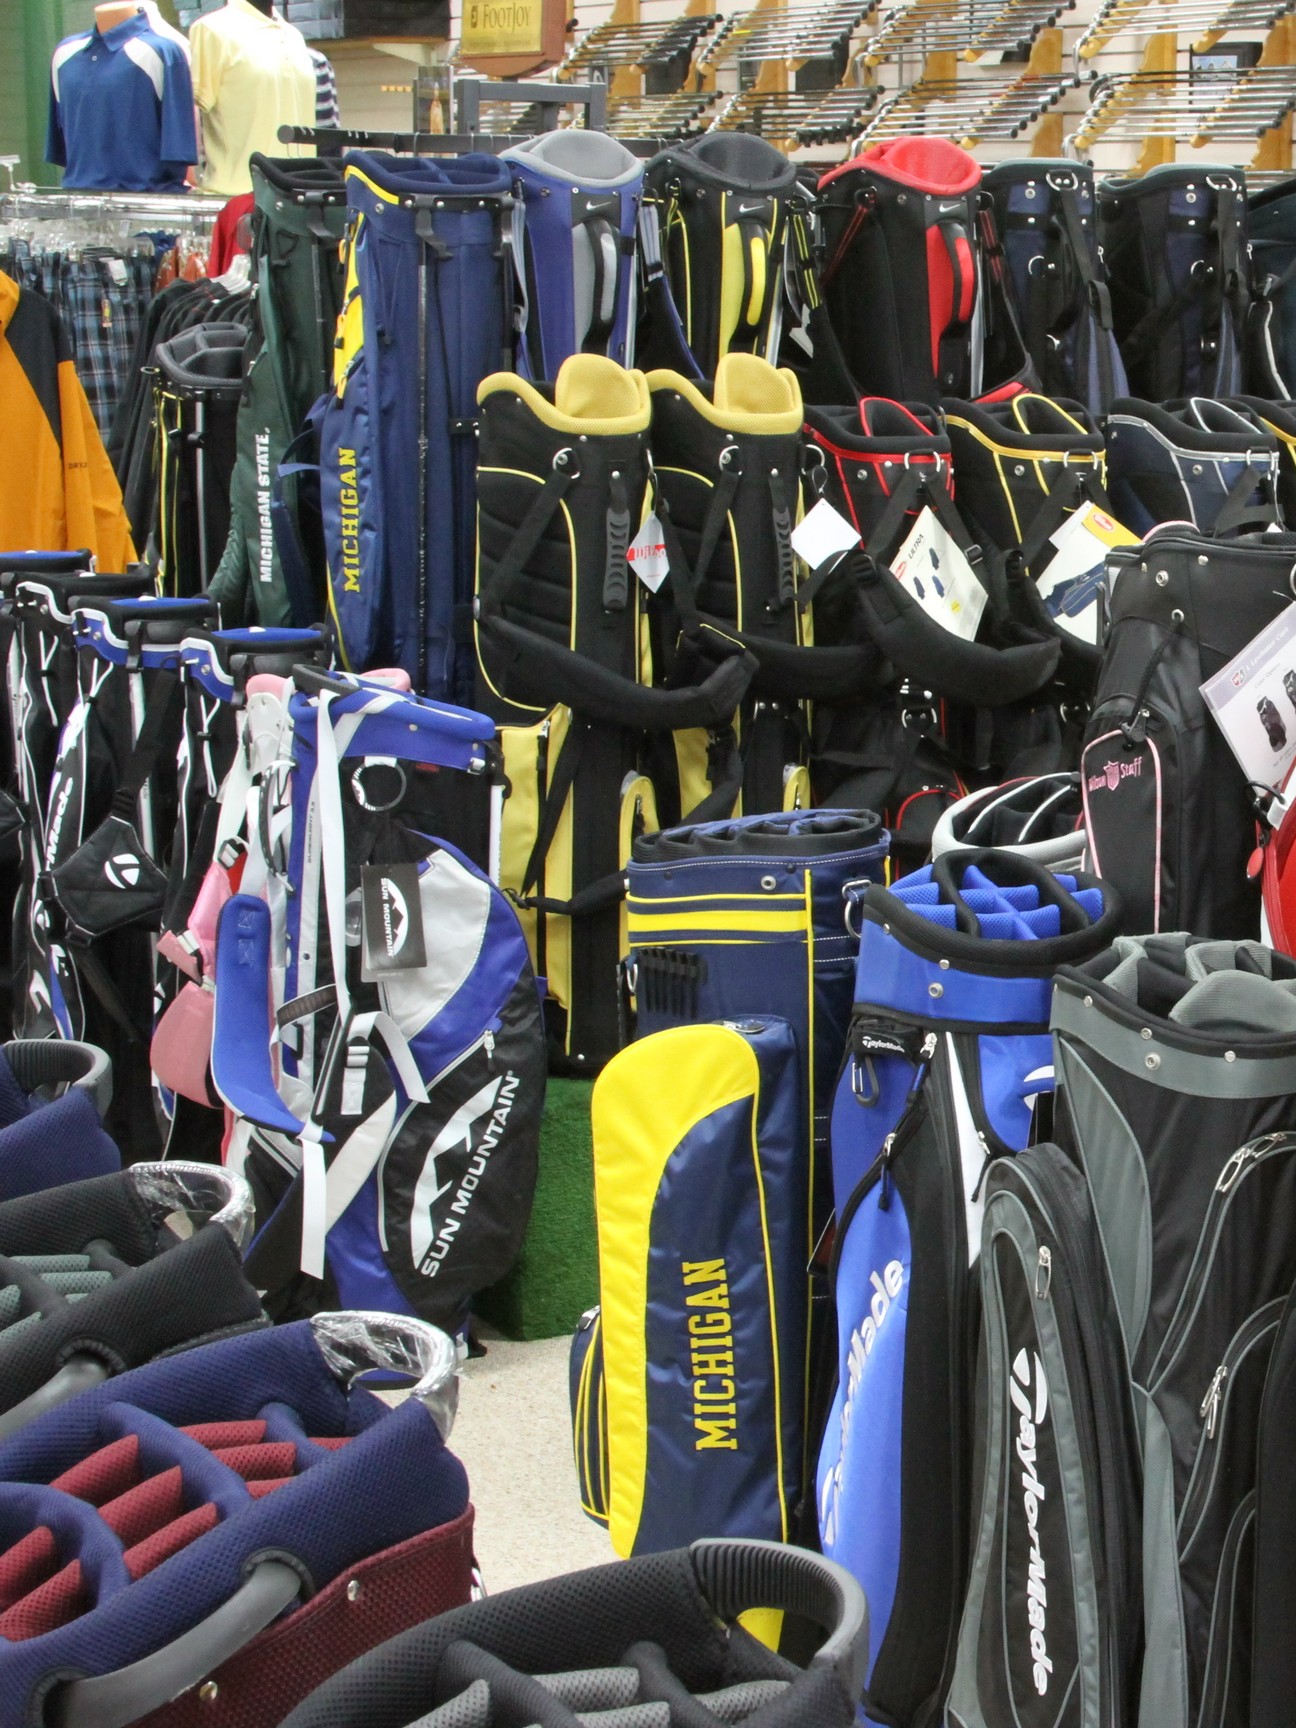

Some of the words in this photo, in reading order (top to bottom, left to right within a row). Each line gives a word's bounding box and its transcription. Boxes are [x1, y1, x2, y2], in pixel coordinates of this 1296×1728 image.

[255, 433, 271, 487] STATE
[257, 491, 273, 583] MICHIGAN
[338, 447, 361, 593] MICHIGAN
[1120, 756, 1143, 779] Staff
[380, 877, 389, 900] SUN
[383, 903, 395, 957] MOUNTAIN
[421, 1218, 462, 1278] SUN
[451, 1076, 520, 1215] MOUNTAIN
[682, 1258, 738, 1451] MICHIGAN
[1010, 1347, 1053, 1696] TaylorMade
